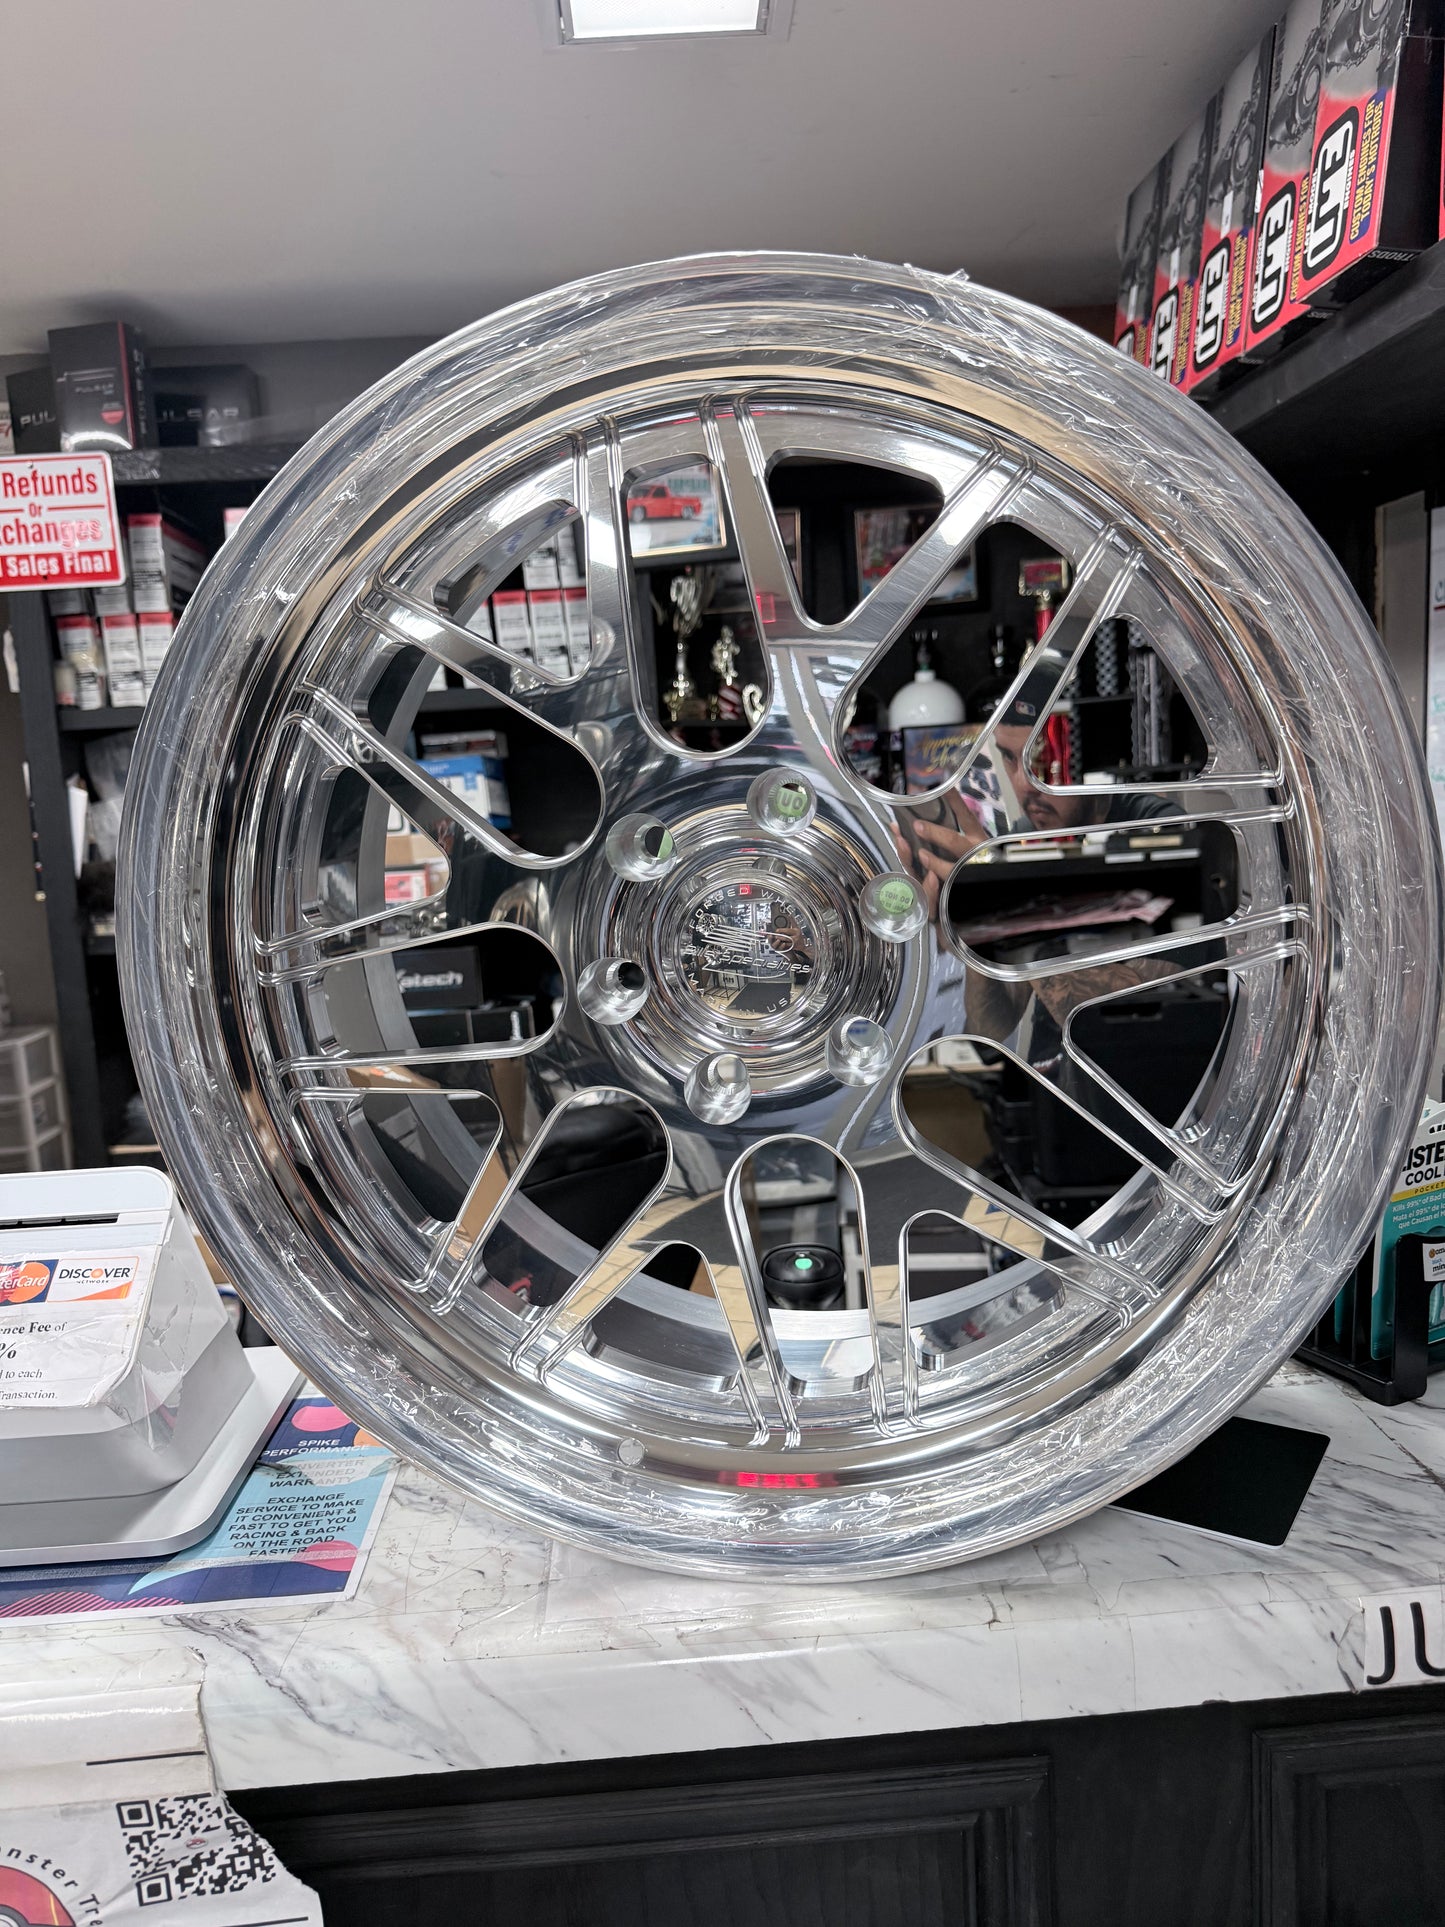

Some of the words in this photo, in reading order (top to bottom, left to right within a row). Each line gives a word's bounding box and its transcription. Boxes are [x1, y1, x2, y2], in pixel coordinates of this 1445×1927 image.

[1363, 98, 1375, 128] FOR
[1367, 100, 1384, 162] HOTRODS
[1357, 128, 1371, 185] ENGINES
[1344, 150, 1355, 210] ENGINES
[1360, 164, 1375, 222] TODAY'S
[1350, 185, 1365, 240] CUSTOM
[2, 467, 97, 498] Refunds
[29, 502, 42, 517] Or
[0, 518, 102, 548] changes
[6, 556, 60, 577] Sales
[62, 551, 112, 574] Final
[689, 886, 750, 929] FORGED
[1405, 1166, 1441, 1186] COOL
[1414, 1182, 1445, 1195] POCKET
[1392, 1204, 1405, 1213] Kills
[1422, 1196, 1429, 1204] of
[1429, 1193, 1441, 1202] Bad
[1392, 1213, 1407, 1222] Mata
[1398, 1221, 1410, 1229] que
[1411, 1214, 1433, 1225] Causan
[59, 1267, 131, 1279] DISCOVER
[29, 1321, 52, 1333] Fee
[54, 1321, 68, 1332] of
[5, 1370, 15, 1379] to
[18, 1369, 43, 1379] each
[298, 1438, 341, 1447] SPIKE
[263, 1445, 371, 1457] PERFORMANCE
[281, 1459, 365, 1471] NVERTER
[269, 1476, 355, 1488] WARRANTY
[236, 1504, 298, 1514] SERVICE
[302, 1502, 320, 1511] TO
[323, 1498, 365, 1509] MAKE
[267, 1492, 346, 1504] EXCHANGE
[235, 1515, 249, 1523] IT
[251, 1508, 344, 1522] CONVENIENT
[346, 1507, 357, 1515] &
[228, 1522, 267, 1532] FAST
[270, 1521, 289, 1529] TO
[293, 1519, 323, 1528] GET
[327, 1516, 357, 1524] YOU
[230, 1530, 287, 1541] RACING
[290, 1529, 300, 1537] &
[305, 1525, 347, 1536] BACK
[233, 1541, 257, 1549] ON
[260, 1538, 289, 1547] THE
[293, 1535, 335, 1545] ROAD
[248, 1546, 308, 1558] FASTER
[0, 1846, 78, 1888] nster
